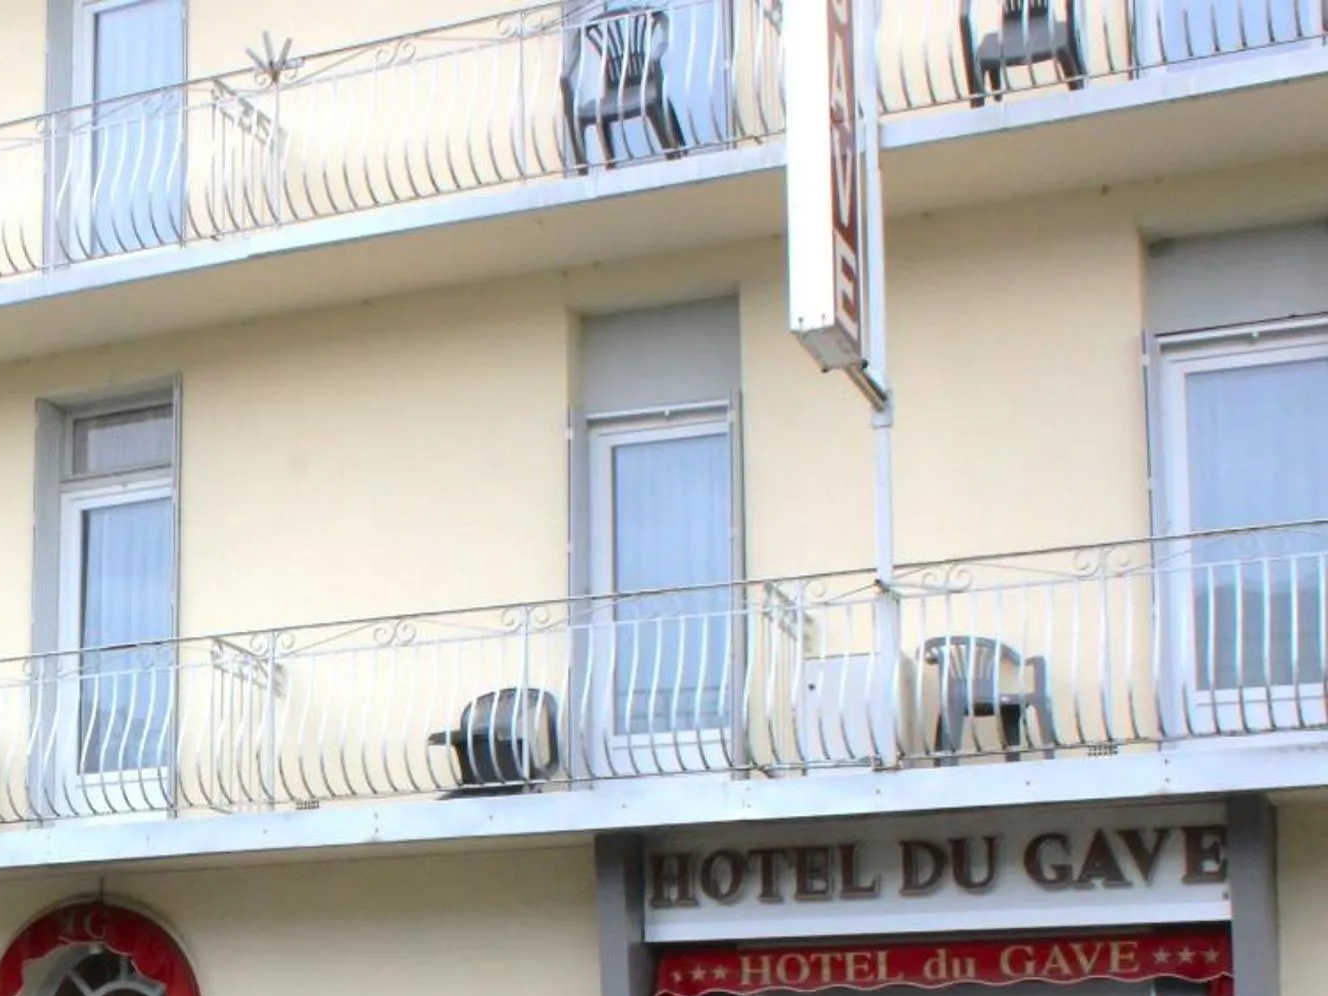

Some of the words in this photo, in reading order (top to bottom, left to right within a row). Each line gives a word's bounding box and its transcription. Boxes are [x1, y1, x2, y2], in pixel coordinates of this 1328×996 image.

[649, 842, 881, 910] HOTEL
[899, 836, 1002, 897] DU
[1023, 825, 1228, 891] GAVE
[739, 950, 905, 987] HOTEL
[923, 948, 976, 981] du
[999, 941, 1140, 978] GAVE
